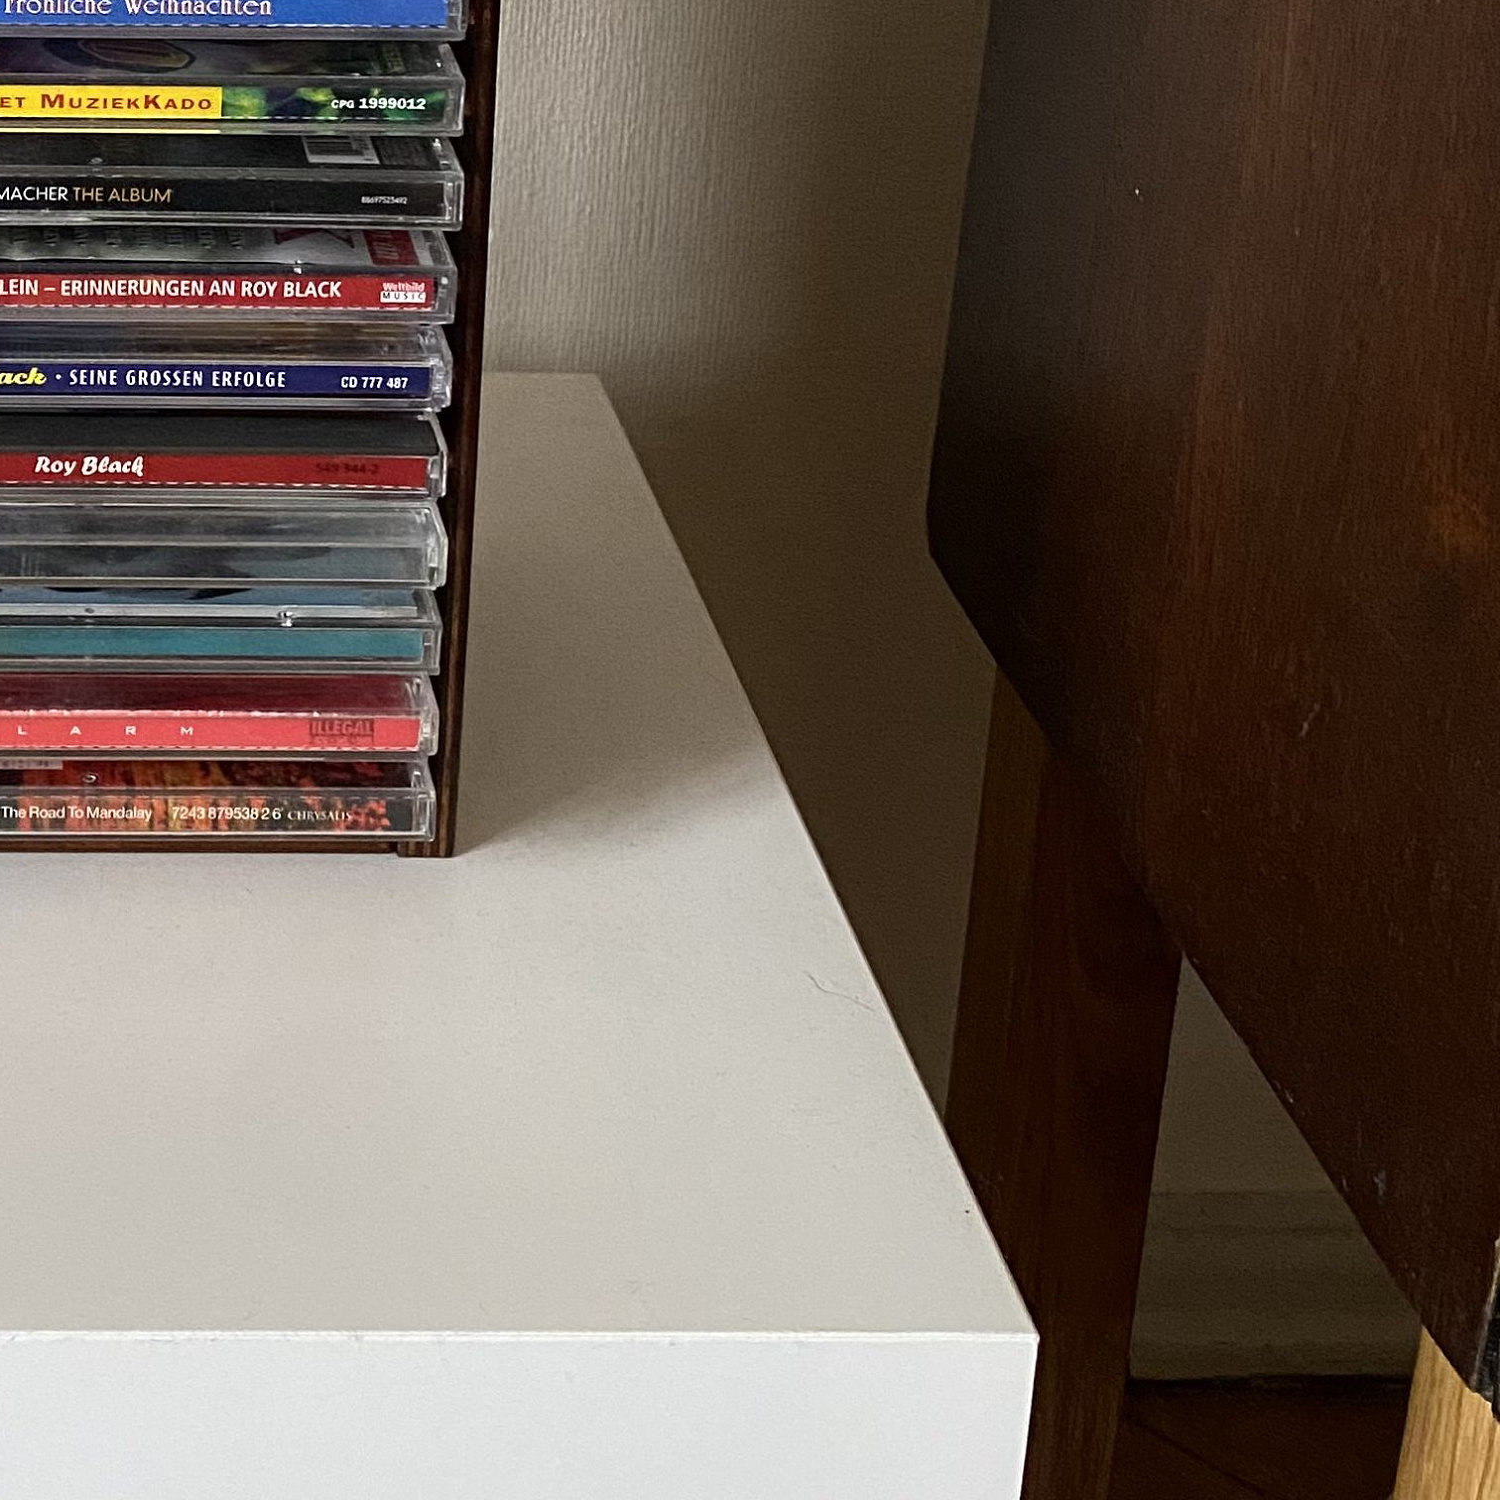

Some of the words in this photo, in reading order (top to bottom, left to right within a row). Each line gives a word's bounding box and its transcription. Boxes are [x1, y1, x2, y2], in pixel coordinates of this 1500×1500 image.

[358, 97, 426, 110] 1999012
[72, 187, 103, 202] THE
[108, 187, 172, 203] ALBUM
[61, 280, 202, 296] ERINNERUNGEN
[208, 281, 235, 296] AN
[241, 281, 278, 297] ROY
[283, 281, 341, 297] BLACK
[69, 370, 117, 385] SEINE
[125, 370, 203, 386] GROSSEN
[212, 372, 286, 387] ERFOLGE
[341, 377, 358, 388] CD
[362, 377, 383, 388] 777
[387, 377, 408, 389] 487
[35, 457, 77, 475] Roy
[81, 457, 144, 476] Black
[311, 720, 374, 735] ILLEGAL
[29, 806, 65, 820] Road
[69, 806, 85, 820] To
[86, 806, 153, 821] Mandalay
[172, 807, 205, 820] 7243
